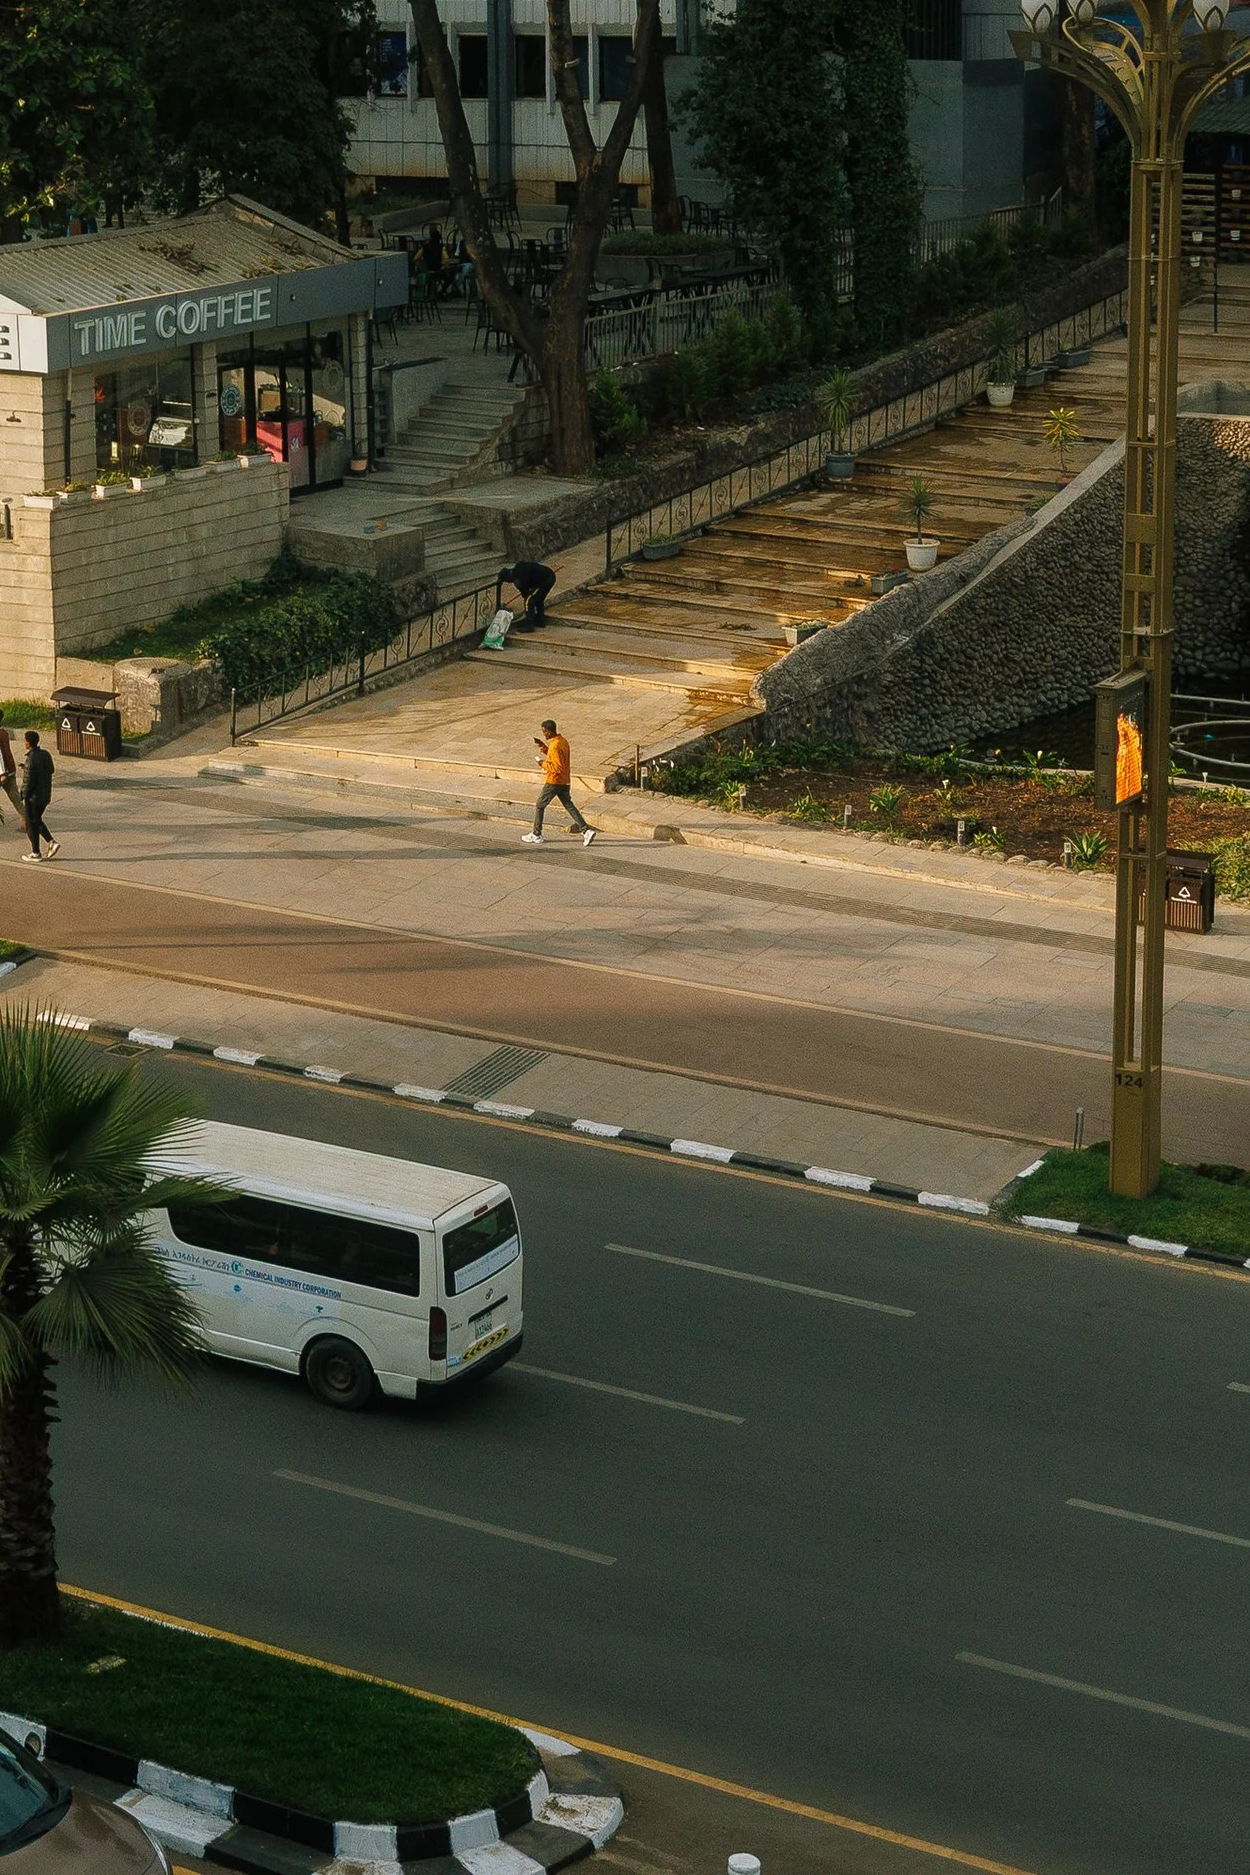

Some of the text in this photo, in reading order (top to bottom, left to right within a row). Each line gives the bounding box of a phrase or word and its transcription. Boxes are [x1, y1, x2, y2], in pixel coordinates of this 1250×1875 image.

[74, 288, 272, 356] TIME COFFEE
[1115, 1072, 1143, 1089] 124
[245, 1268, 342, 1299] CHEMICAL INDUSTRY CORPORATION
